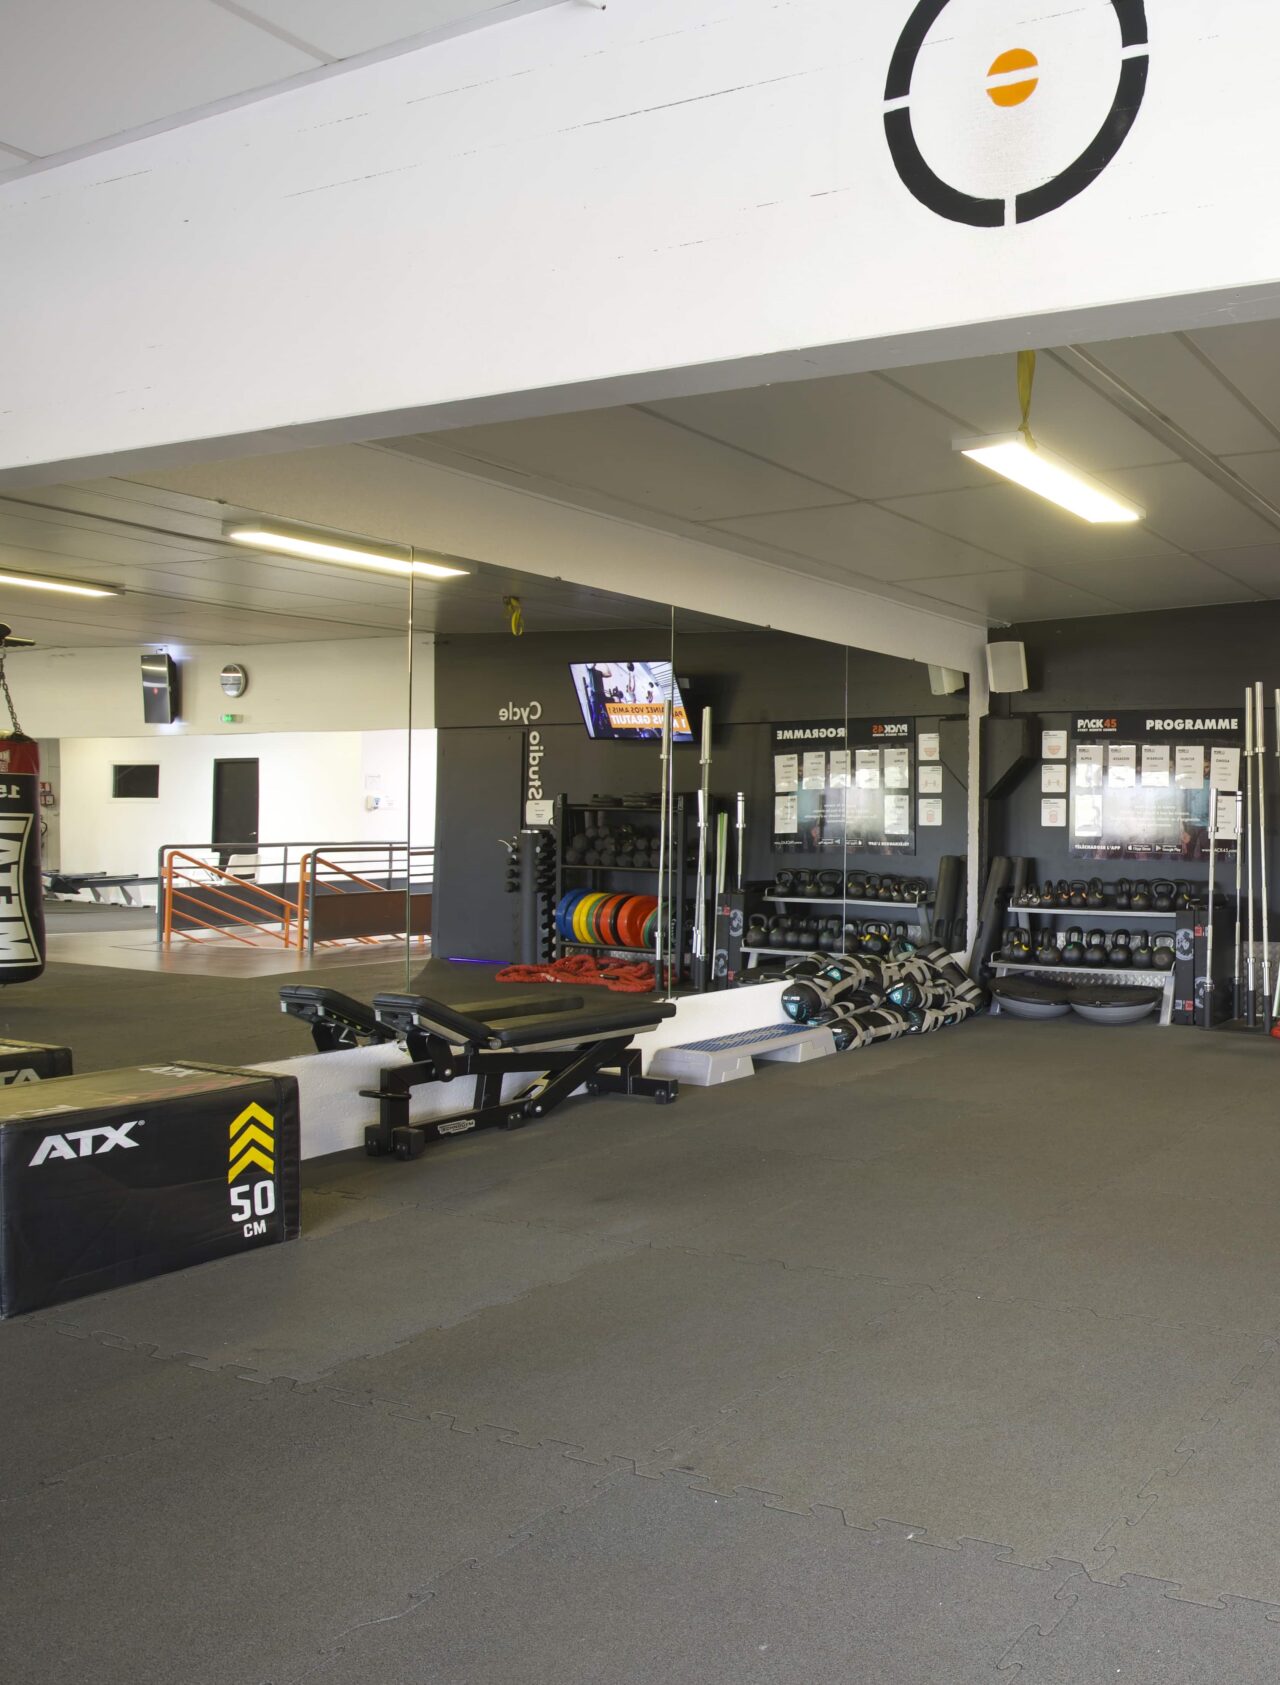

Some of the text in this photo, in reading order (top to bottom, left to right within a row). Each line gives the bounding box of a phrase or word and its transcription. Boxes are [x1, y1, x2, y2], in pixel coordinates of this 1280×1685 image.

[1145, 718, 1239, 731] PROGRAMME
[28, 1120, 141, 1167] ATX
[229, 1179, 276, 1223] 50
[242, 1219, 268, 1238] CM
